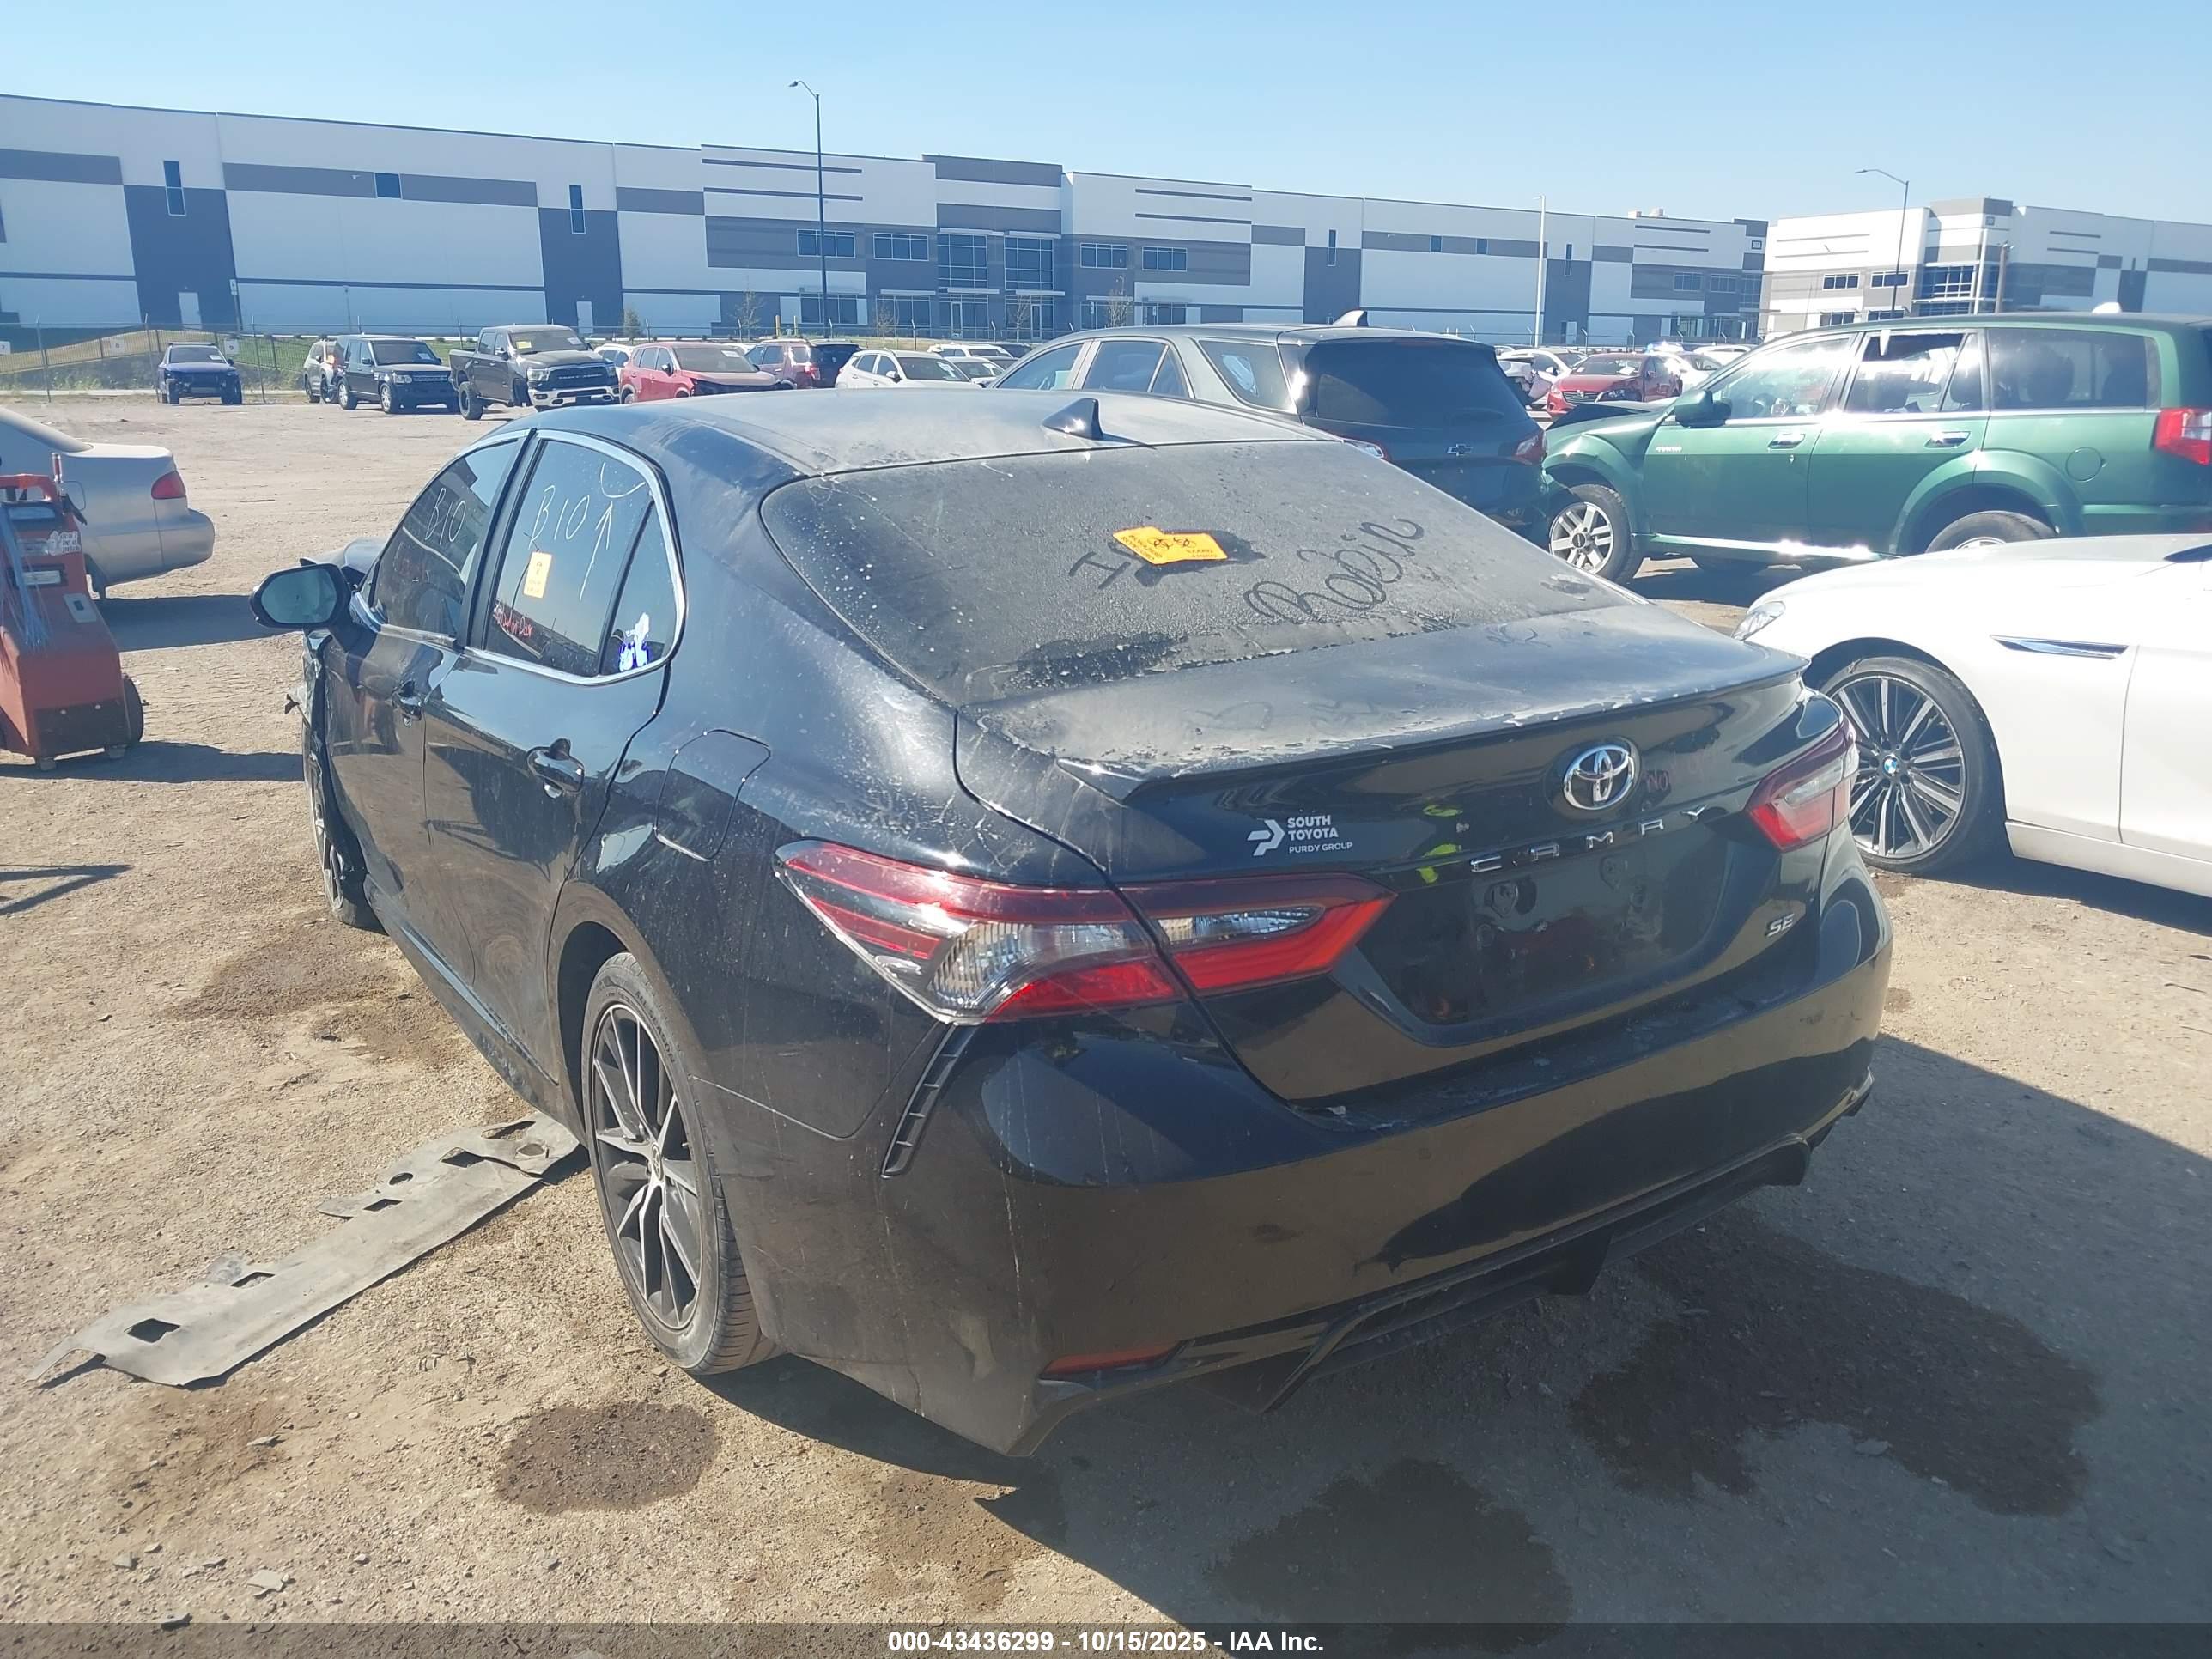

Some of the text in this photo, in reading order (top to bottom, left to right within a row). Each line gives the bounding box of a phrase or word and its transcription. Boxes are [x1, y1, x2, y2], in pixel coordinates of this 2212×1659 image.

[1287, 815, 1331, 829] SOUTH
[1288, 827, 1339, 841] TOYOTA
[1470, 804, 1707, 874] CAMRY
[1289, 842, 1353, 854] PURDY GROUP
[1765, 914, 1795, 937] SE
